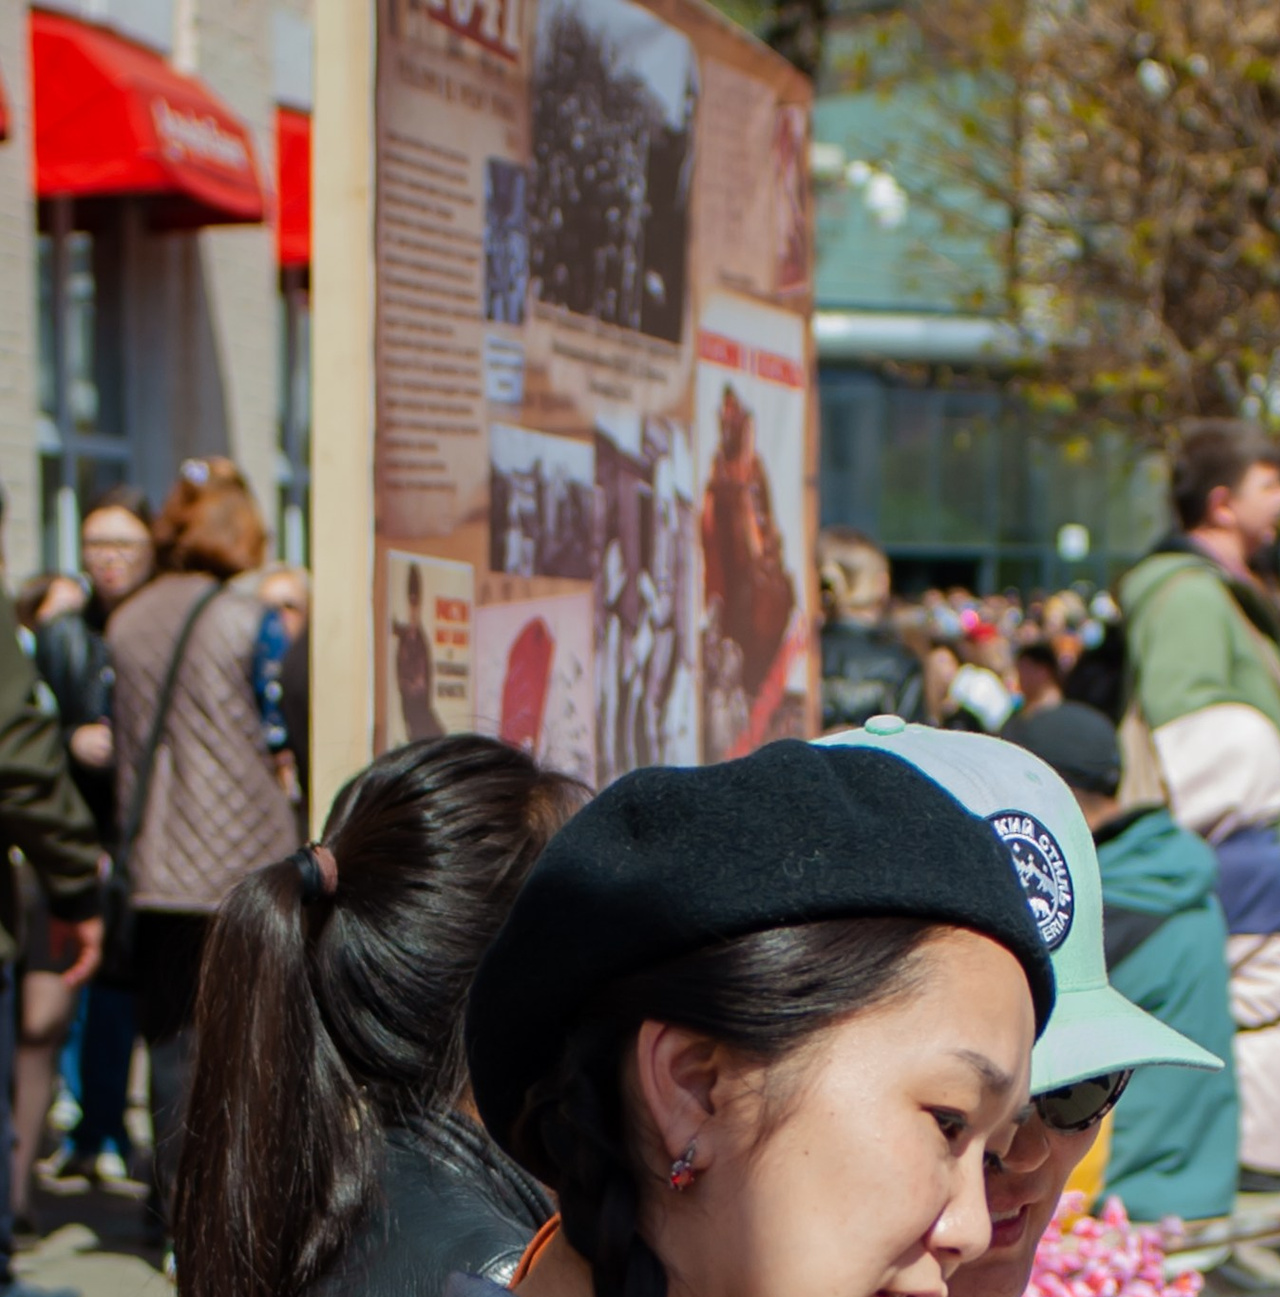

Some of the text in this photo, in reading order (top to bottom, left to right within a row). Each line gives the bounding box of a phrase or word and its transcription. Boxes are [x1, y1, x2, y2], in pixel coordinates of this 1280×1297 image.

[993, 816, 1071, 906] КИЙ СТИЛЬ
[1041, 911, 1069, 942] ERIA
